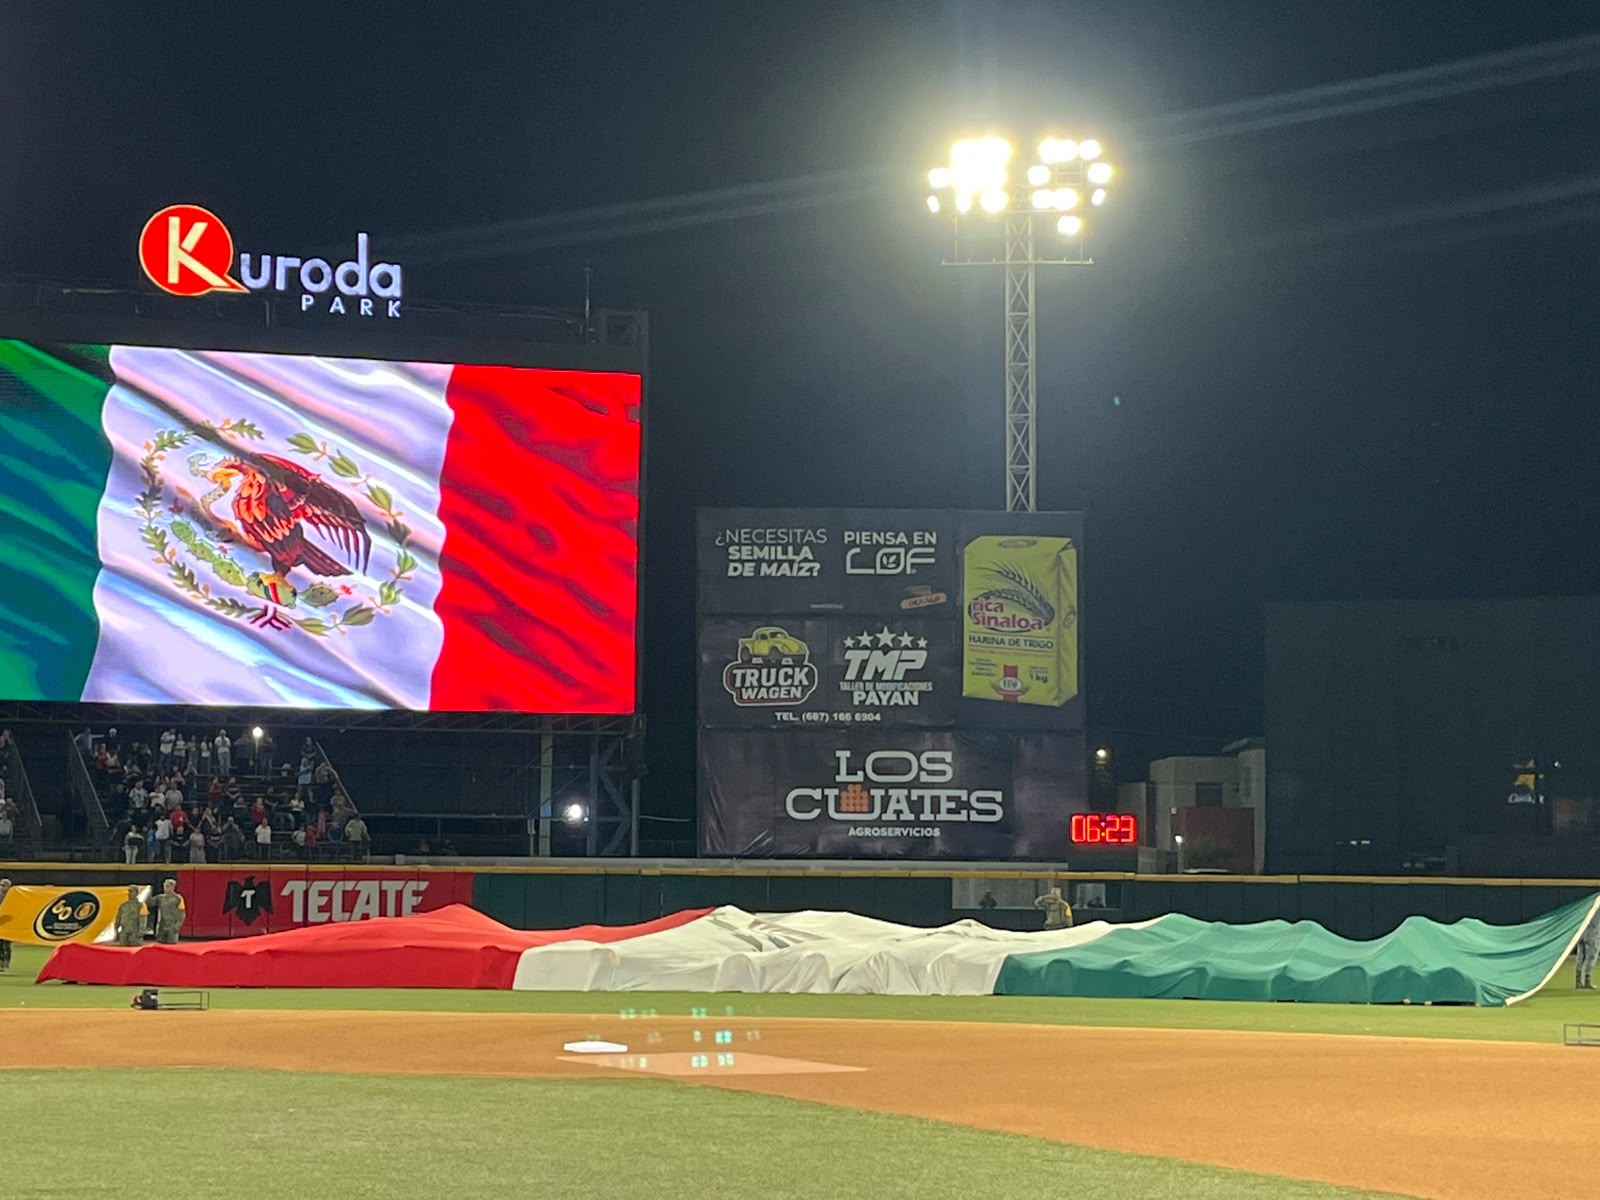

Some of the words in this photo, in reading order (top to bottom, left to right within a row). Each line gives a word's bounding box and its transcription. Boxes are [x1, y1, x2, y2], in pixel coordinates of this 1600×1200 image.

[301, 295, 401, 317] PARK
[715, 528, 827, 546] ¿NECESITAS
[844, 531, 909, 545] PIENSA
[913, 531, 937, 545] EN
[728, 545, 814, 560] SEMILLA
[728, 562, 756, 577] DE
[760, 560, 821, 577] MAÍZ?
[972, 612, 1044, 630] Sinaloa
[969, 635, 1006, 646] HARINA
[1008, 637, 1021, 647] DE
[1023, 639, 1054, 649] TRIGO
[844, 650, 928, 681] TMP
[732, 667, 810, 688] TRUCK
[741, 687, 803, 700] WAGEN
[853, 691, 919, 706] PAYAN
[835, 750, 954, 783] LOS
[785, 788, 1004, 822] CUATES
[848, 827, 941, 838] AGROSERVICIOS
[1071, 814, 1136, 843] 06:23
[280, 880, 430, 923] TECATE
